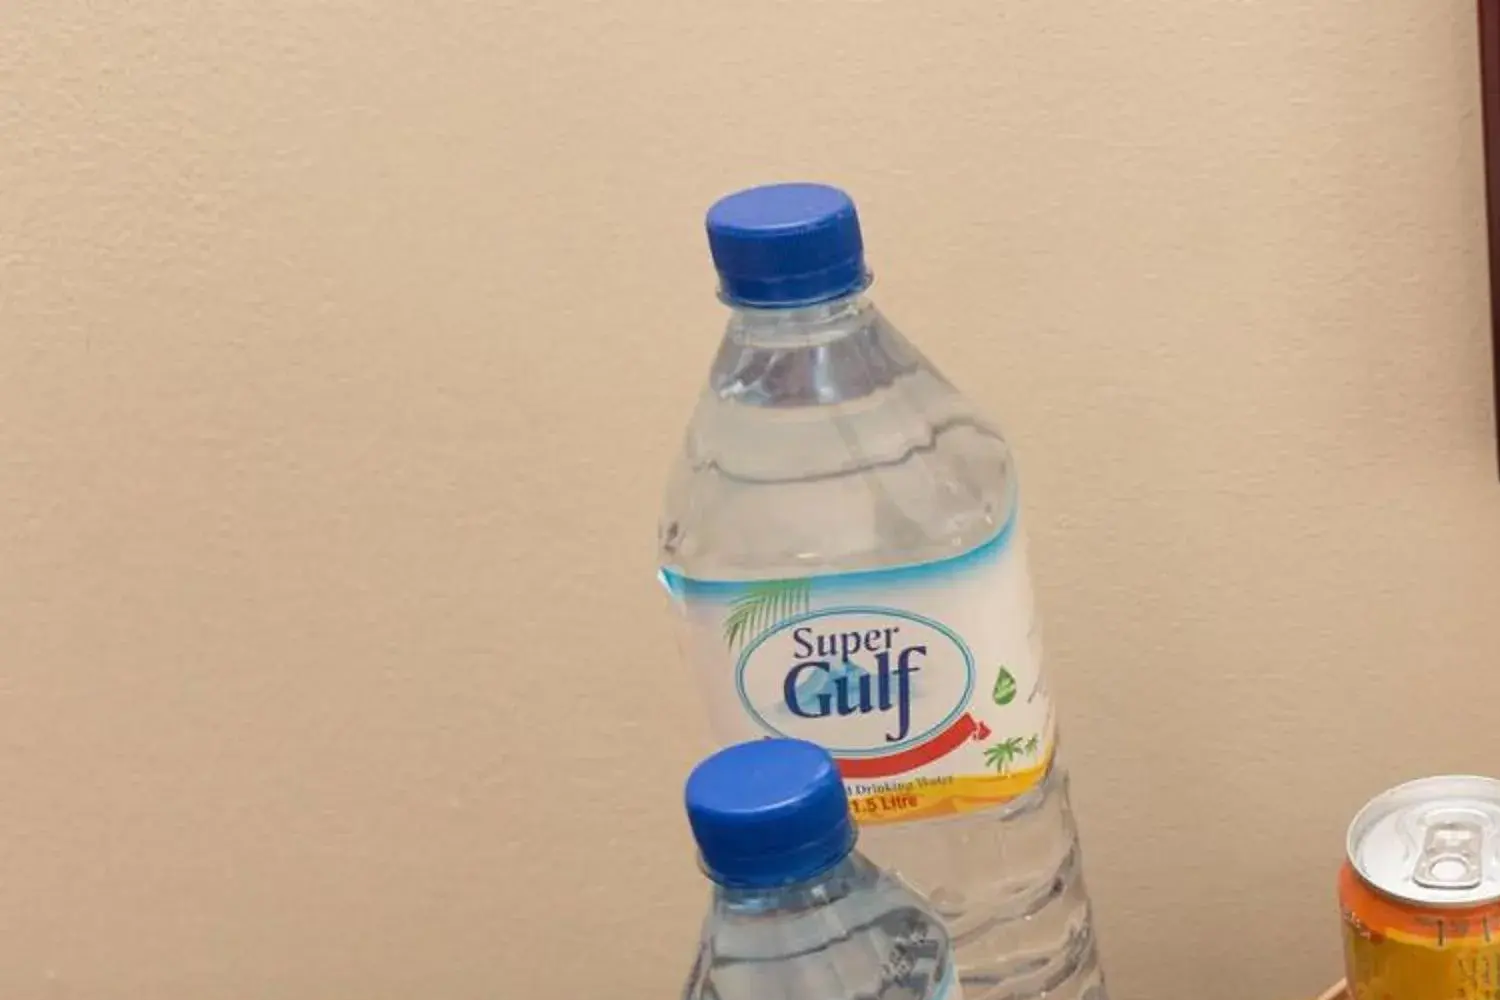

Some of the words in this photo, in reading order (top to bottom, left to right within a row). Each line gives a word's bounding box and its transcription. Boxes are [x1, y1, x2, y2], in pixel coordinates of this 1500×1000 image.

[792, 625, 900, 663] Super
[783, 646, 927, 742] Gulf
[852, 798, 878, 814] 1.5
